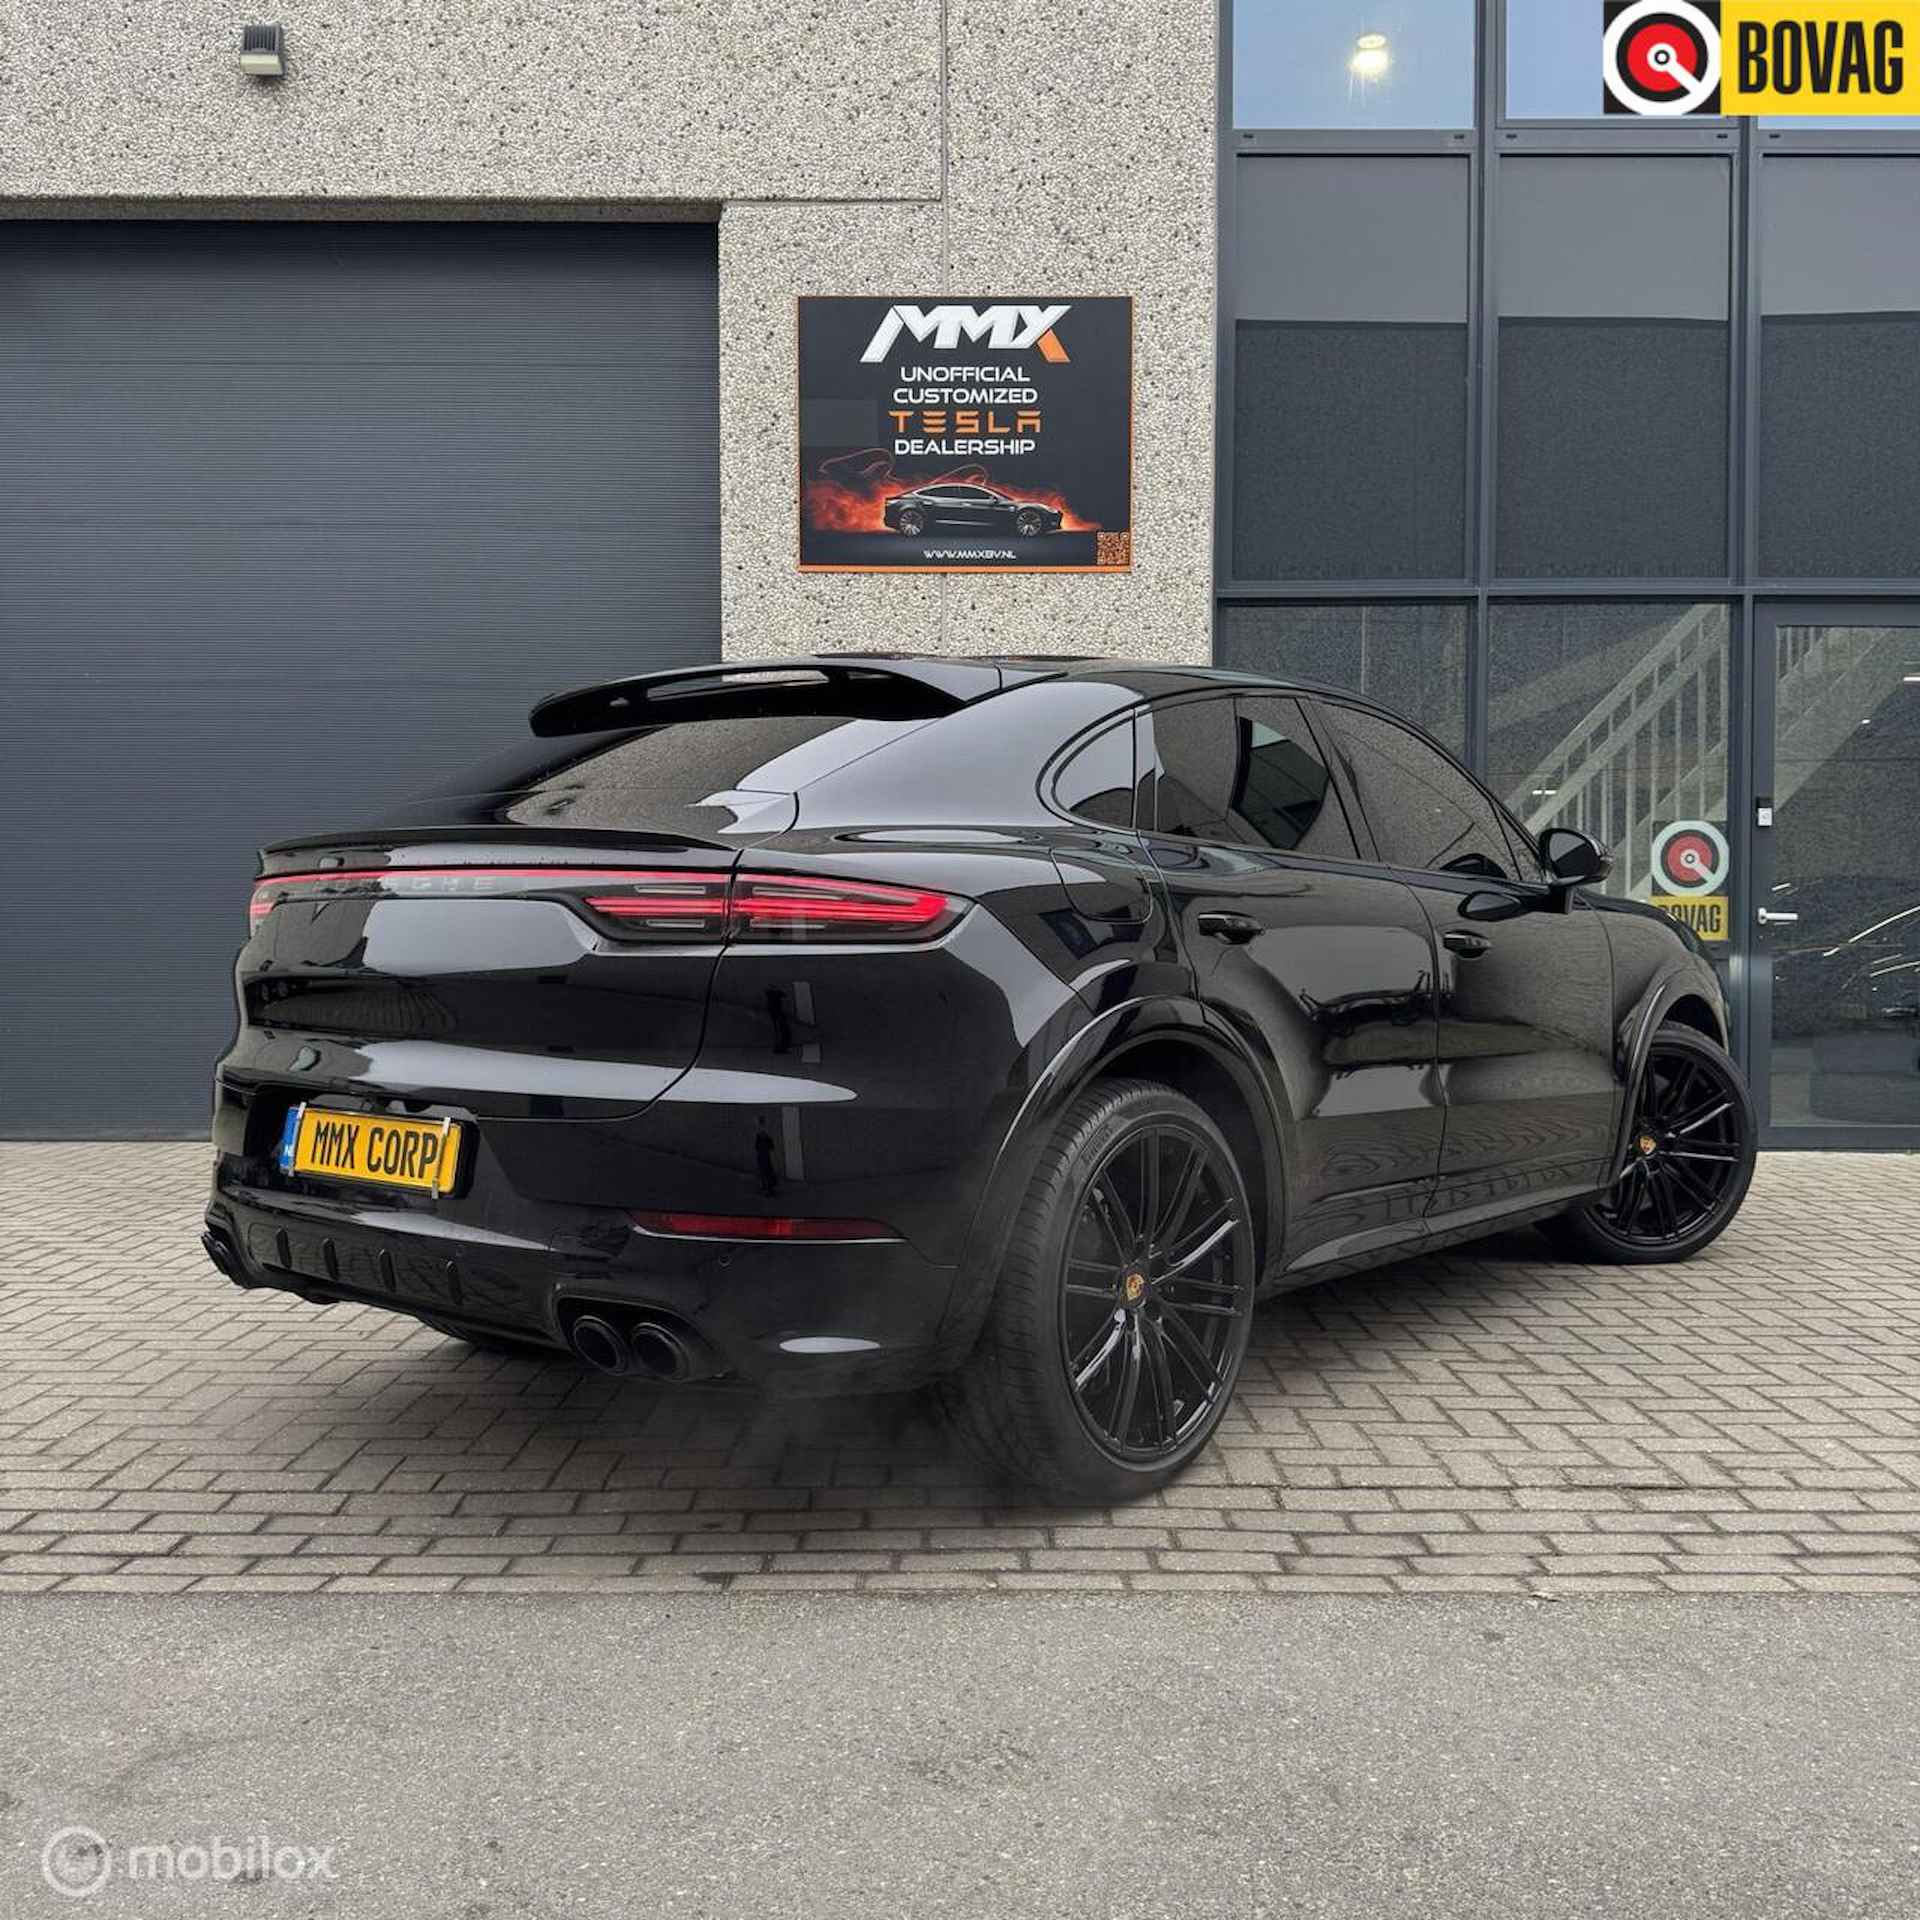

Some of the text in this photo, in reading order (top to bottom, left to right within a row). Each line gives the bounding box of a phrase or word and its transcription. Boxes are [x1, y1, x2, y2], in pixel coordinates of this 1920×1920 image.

[860, 305, 1071, 363] MMX
[900, 366, 1030, 382] UNOFFICIAL
[893, 388, 1038, 405] CUSTOMIZED
[889, 411, 1041, 433] TESLA
[894, 439, 1036, 455] DEALERSHIP
[1658, 904, 1721, 933] VAG
[311, 1120, 439, 1179] MMX CORP
